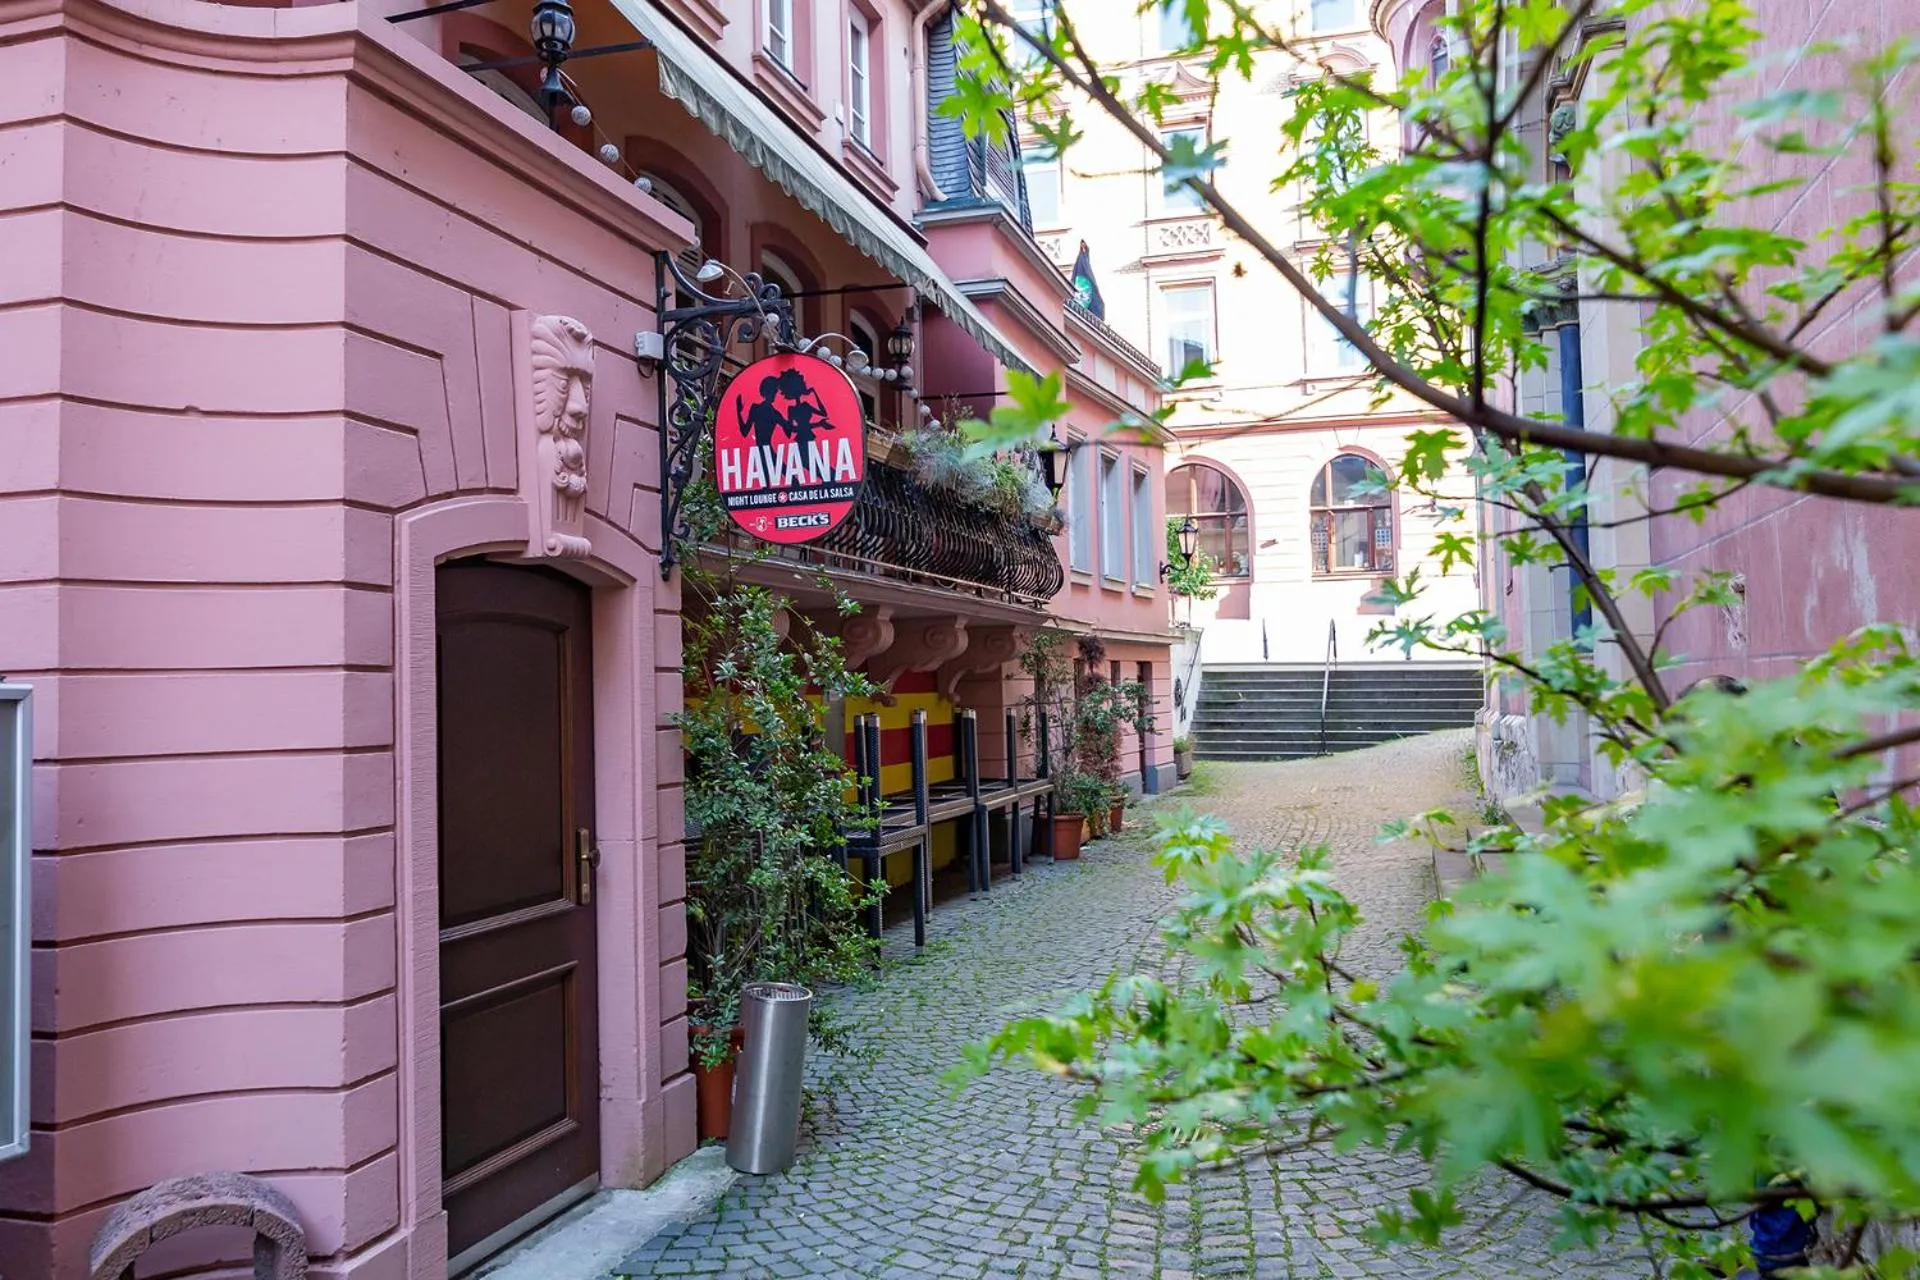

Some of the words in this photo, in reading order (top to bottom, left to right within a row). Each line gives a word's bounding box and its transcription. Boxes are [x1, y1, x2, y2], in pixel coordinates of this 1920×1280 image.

[721, 437, 857, 491] HAVANA
[728, 496, 749, 507] NIGHT
[750, 493, 777, 506] LOUNGE
[789, 490, 808, 501] CASA
[809, 489, 818, 500] DE
[820, 488, 829, 499] LA
[830, 487, 854, 498] SALSA
[777, 513, 829, 528] BECK'S
